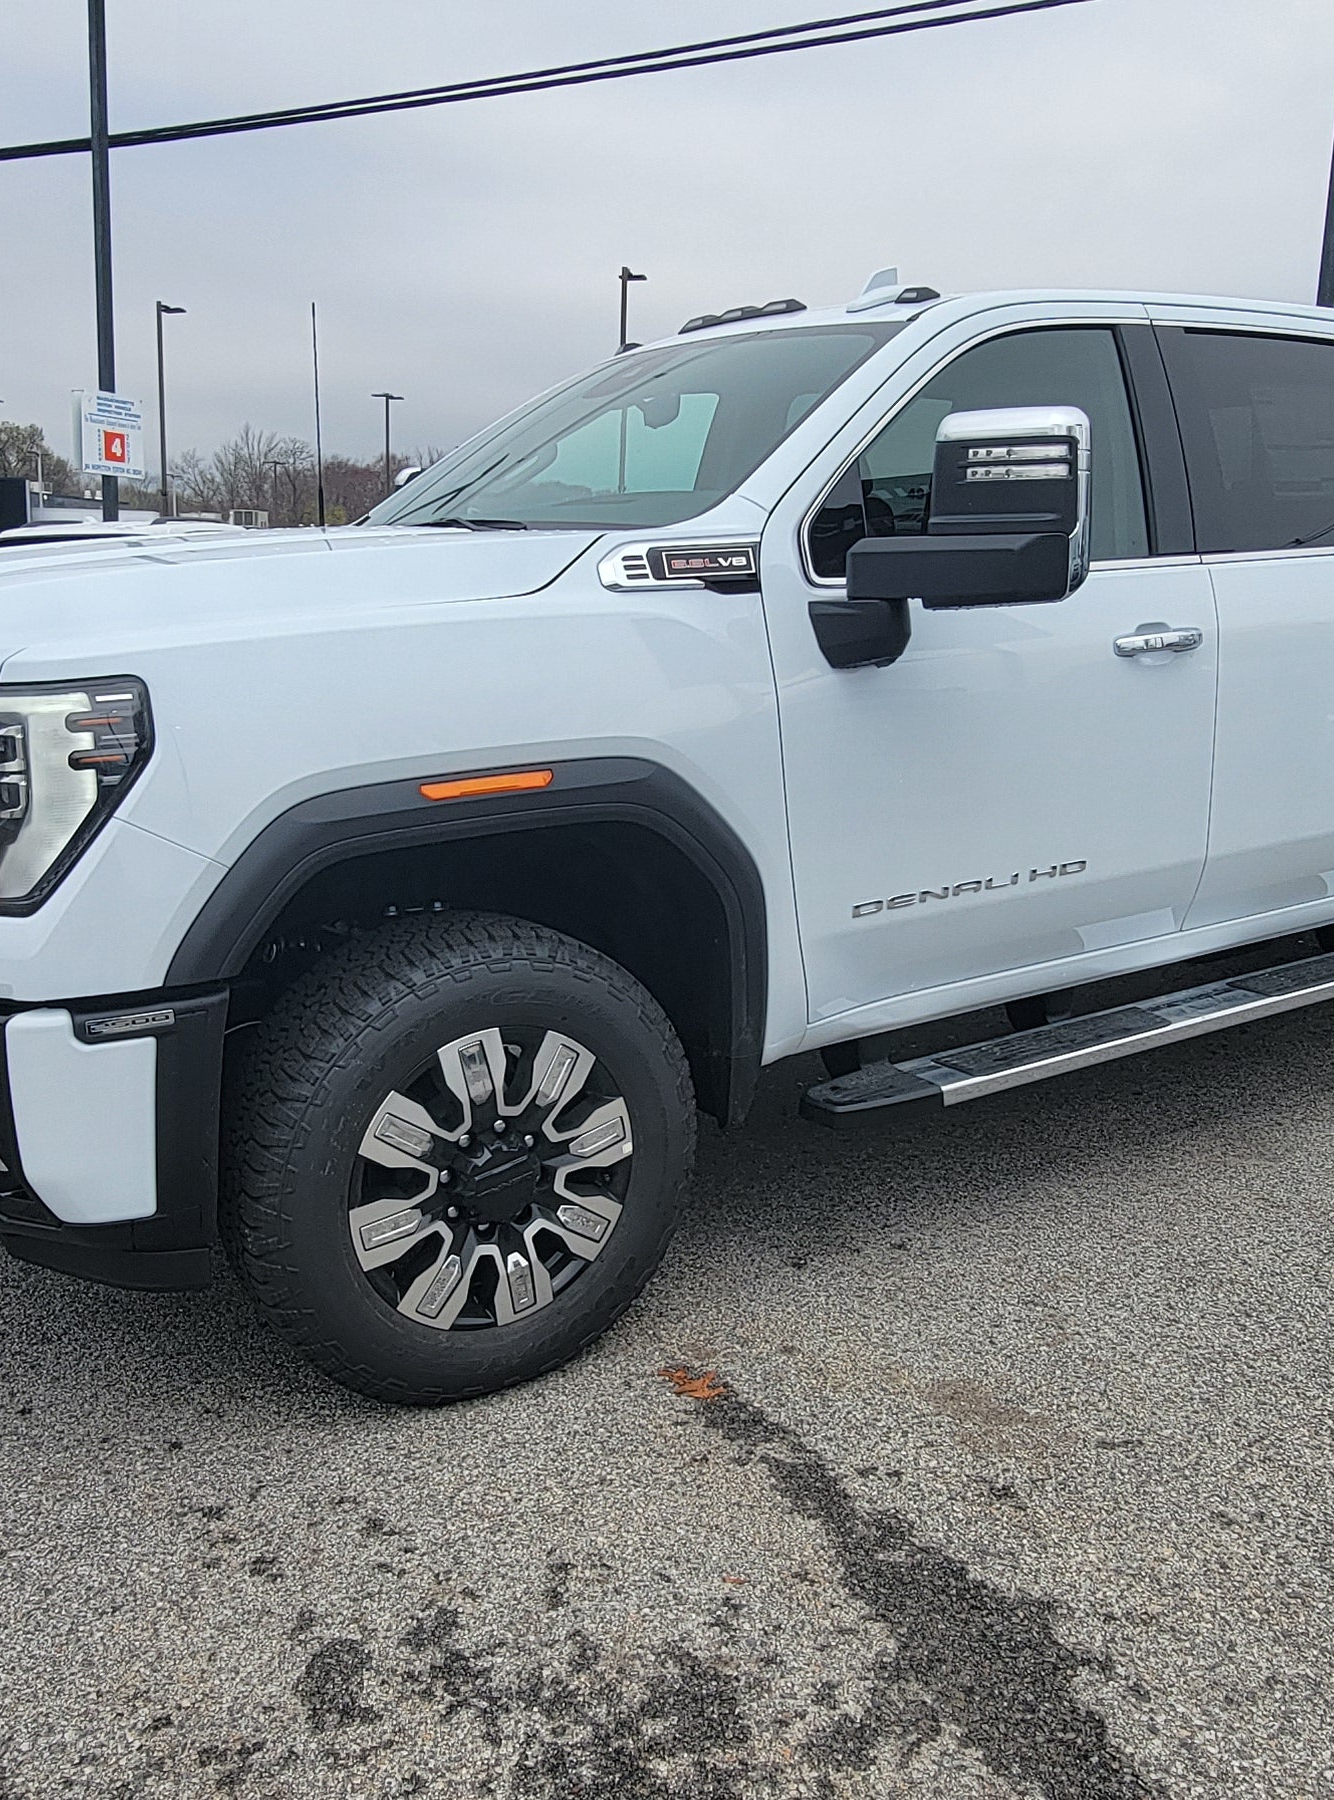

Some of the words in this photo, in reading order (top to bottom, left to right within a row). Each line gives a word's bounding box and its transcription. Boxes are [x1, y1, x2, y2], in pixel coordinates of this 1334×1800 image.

[111, 437, 123, 457] 4
[851, 871, 1020, 919] DENALI
[1028, 859, 1088, 882] HD
